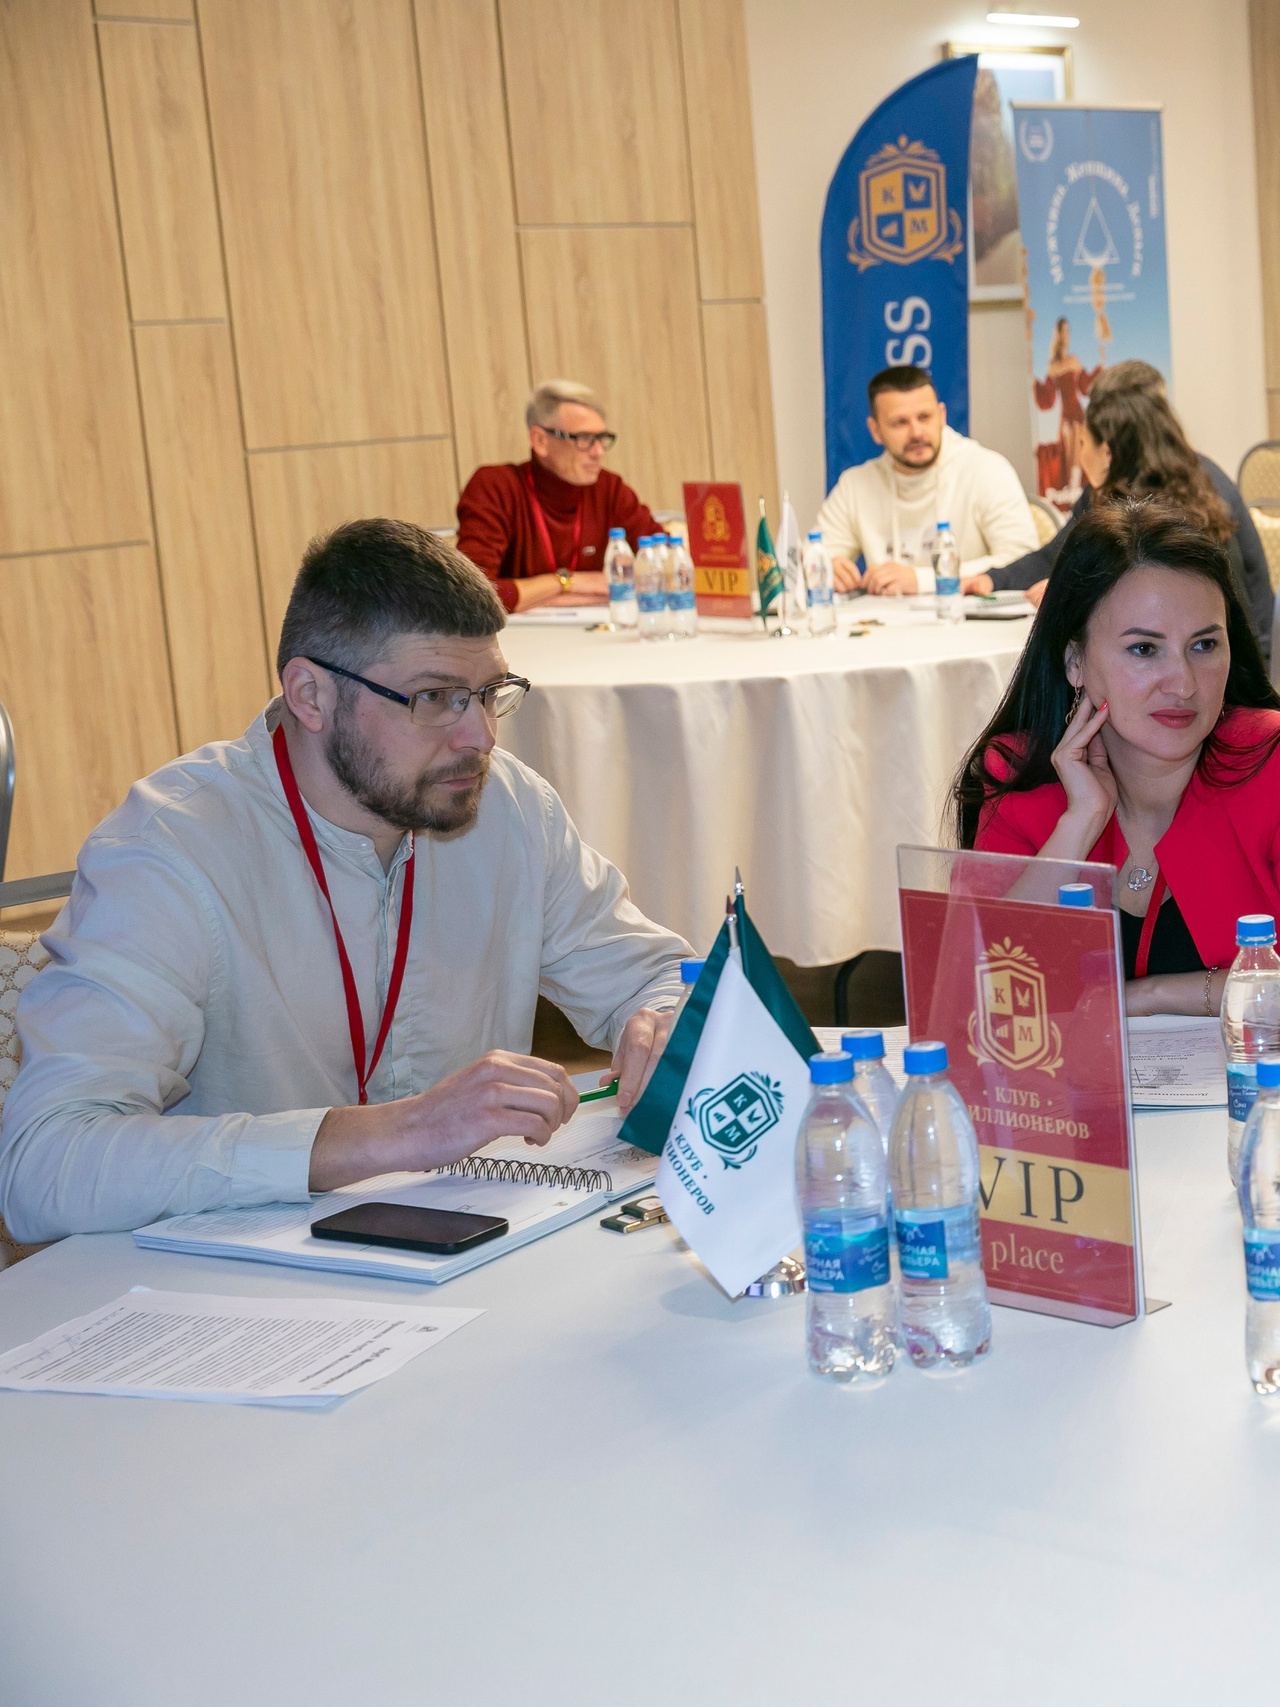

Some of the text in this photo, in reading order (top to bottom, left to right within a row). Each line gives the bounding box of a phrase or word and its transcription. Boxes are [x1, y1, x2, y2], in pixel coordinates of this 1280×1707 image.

[704, 570, 739, 592] VIP
[995, 1087, 1040, 1109] КЛУБ
[674, 1133, 704, 1171] КЛУБ
[979, 1156, 1084, 1224] VIP
[990, 1233, 1064, 1274] place
